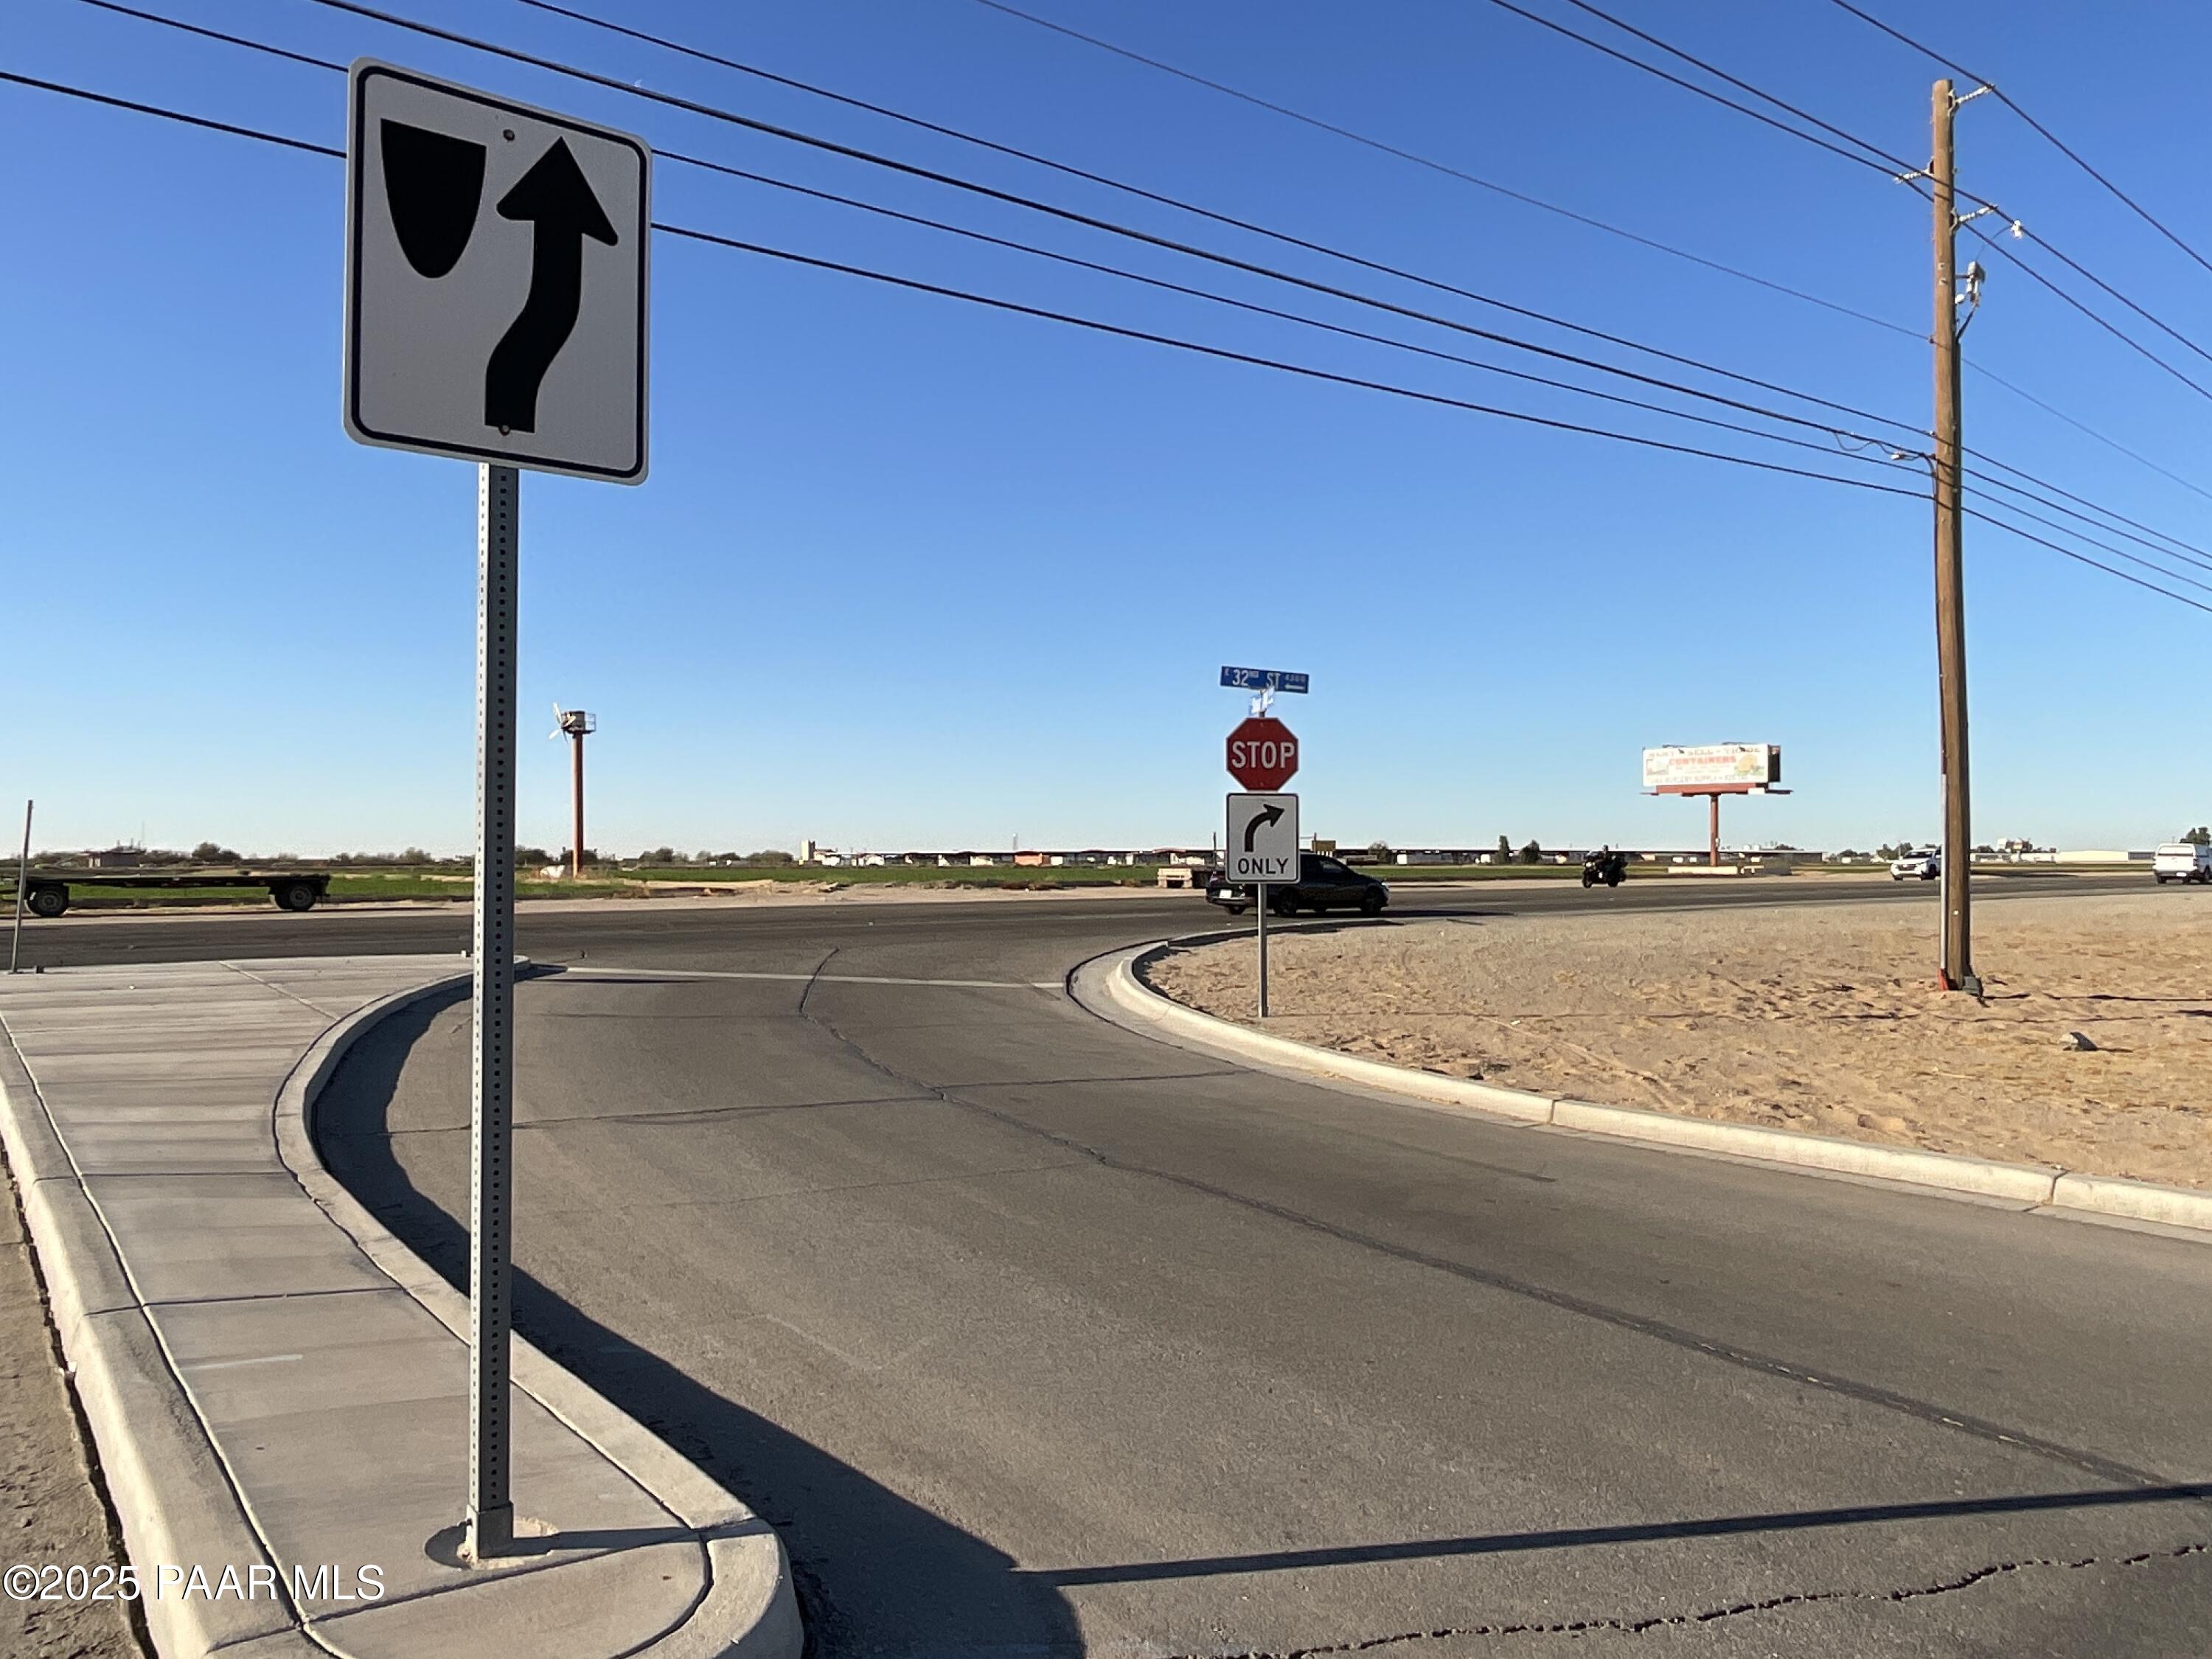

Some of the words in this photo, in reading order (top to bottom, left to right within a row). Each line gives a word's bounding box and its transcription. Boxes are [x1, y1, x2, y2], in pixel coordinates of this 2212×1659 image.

[1265, 672, 1281, 691] ST
[1231, 741, 1295, 768] STOP
[1238, 858, 1289, 874] ONLY
